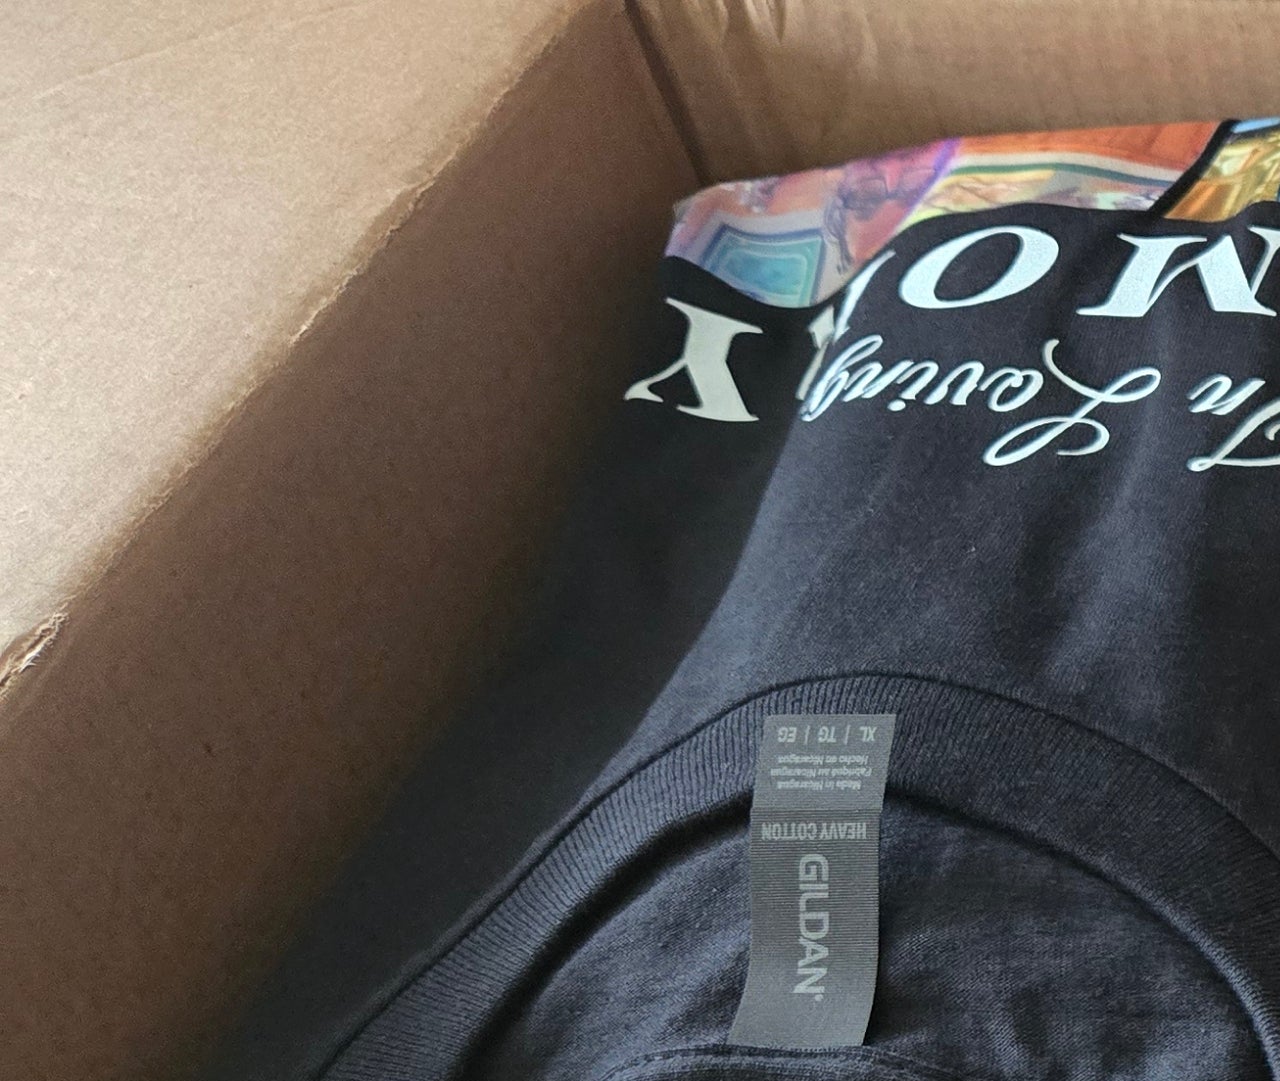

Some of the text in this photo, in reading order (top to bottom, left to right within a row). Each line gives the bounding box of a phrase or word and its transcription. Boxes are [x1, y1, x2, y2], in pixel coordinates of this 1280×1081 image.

[801, 334, 1162, 467] Loving
[777, 725, 878, 743] XL TG EG
[777, 753, 823, 765] Nicaragua
[838, 755, 869, 765] Hecho
[770, 766, 817, 777] Nicaragua
[776, 779, 823, 790] Nicaragua
[836, 779, 862, 790] Made
[760, 822, 868, 841] HEAVY COTTON
[790, 853, 830, 996] GILDAN
